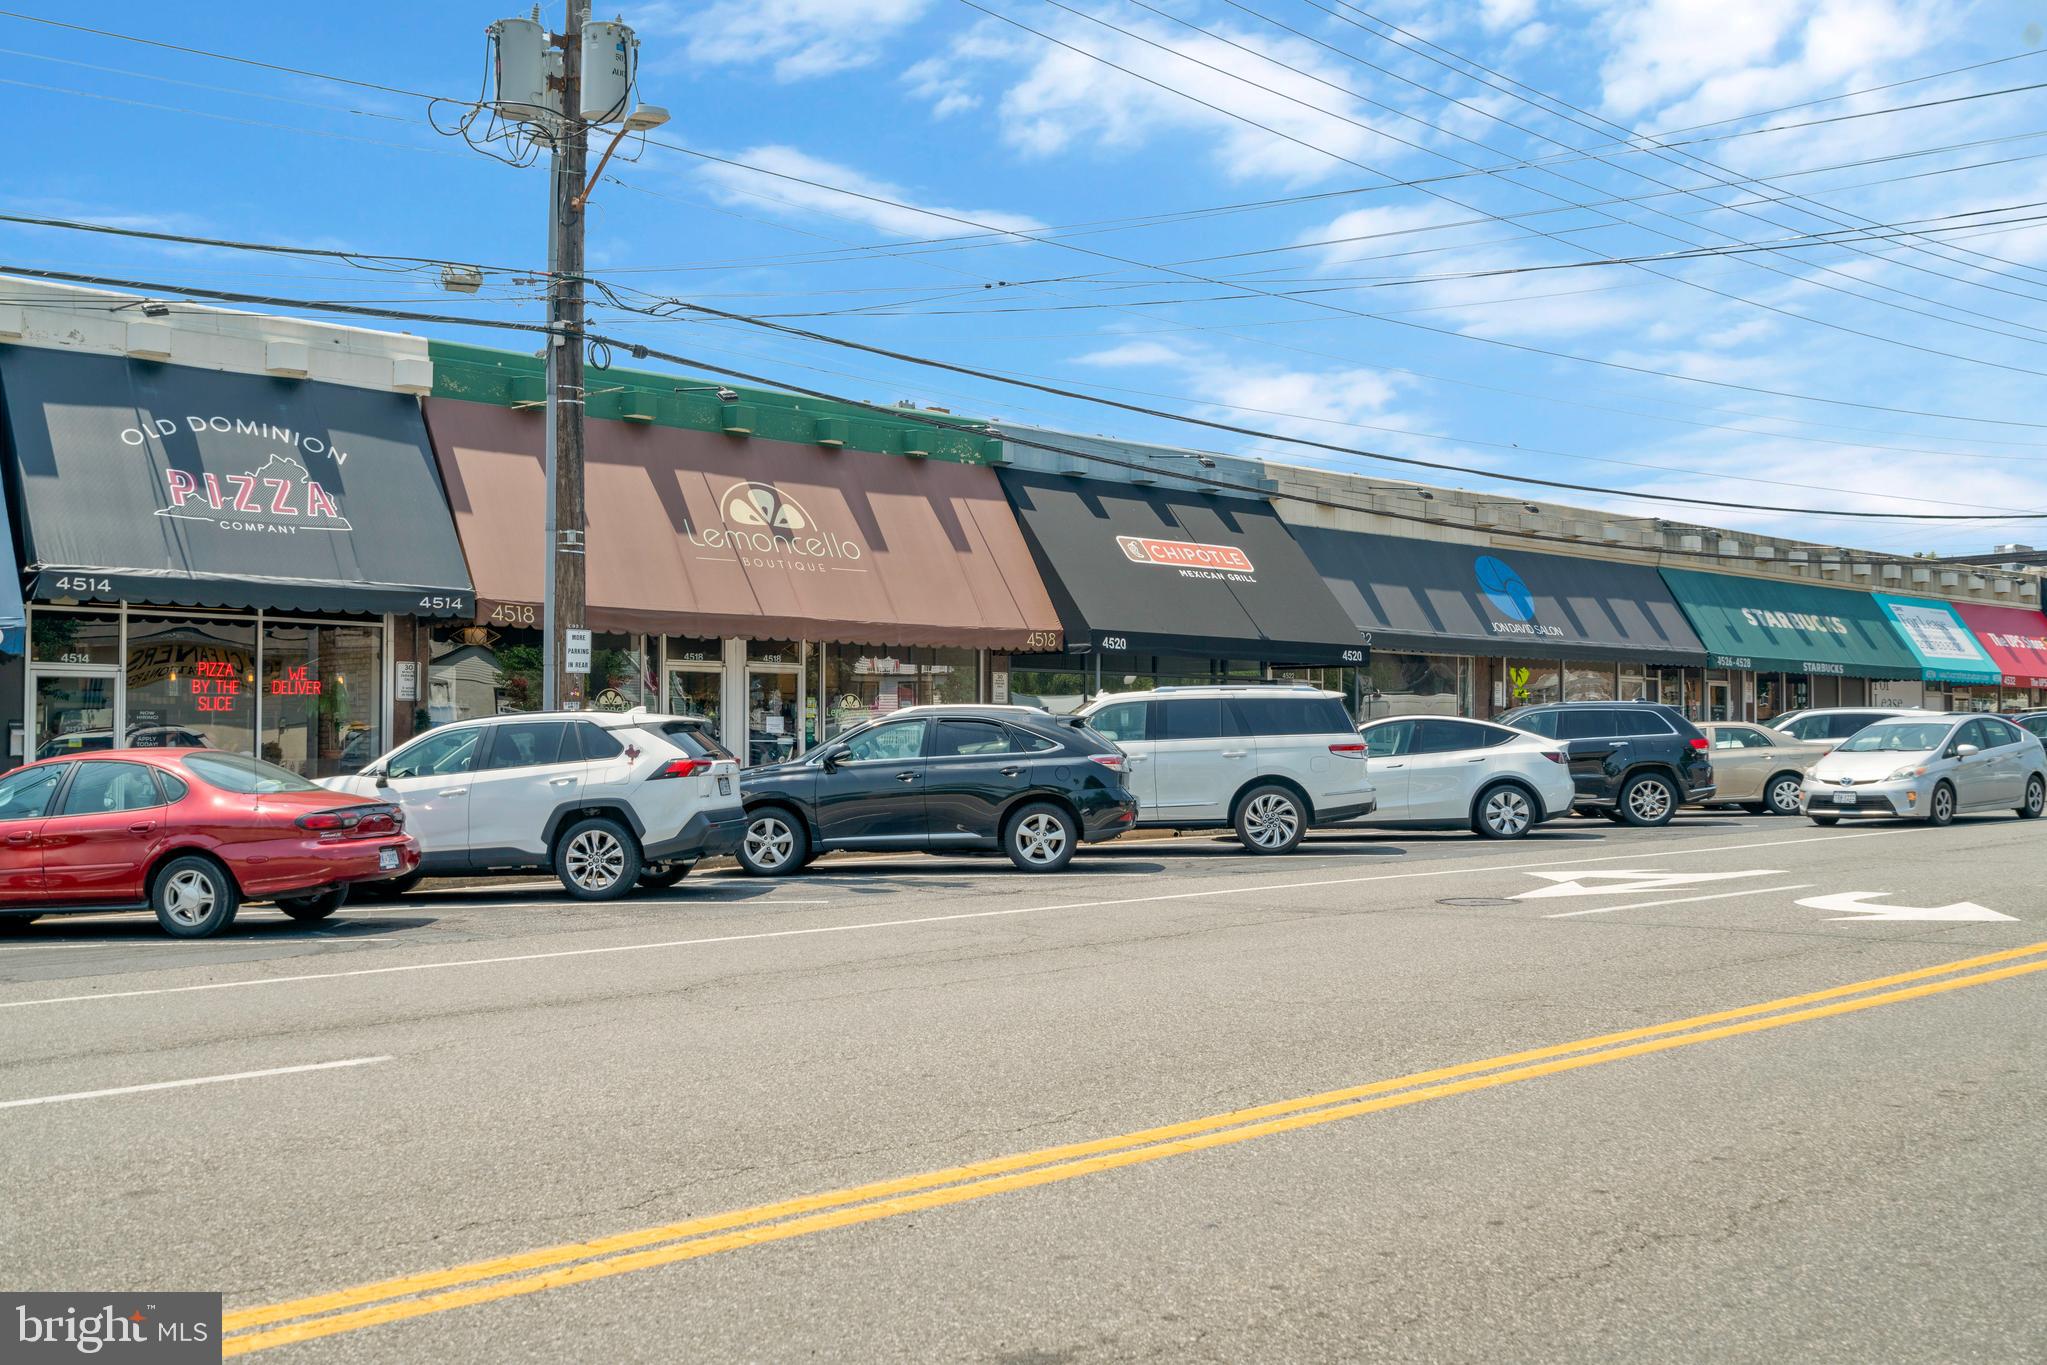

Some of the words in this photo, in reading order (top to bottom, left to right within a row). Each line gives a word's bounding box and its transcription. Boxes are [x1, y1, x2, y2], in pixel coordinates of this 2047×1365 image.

[121, 419, 177, 446] OLD
[186, 416, 348, 465] DOMINION
[166, 468, 338, 517] PIZZA
[219, 520, 296, 534] COMPANY
[683, 518, 861, 560] Lemoncello
[1150, 544, 1246, 567] CHIPOTLE
[742, 557, 827, 573] BOUTIQUE
[1178, 568, 1226, 581] MEXICAN
[1227, 572, 1257, 583] GRILL
[55, 576, 112, 592] 4514
[418, 596, 463, 609] 4514
[490, 604, 535, 623] 4518
[1740, 607, 1848, 634] STARBUCKS
[1507, 622, 1535, 634] DAVID
[1533, 624, 1564, 637] SALON
[1026, 632, 1056, 647] 4518
[1102, 636, 1127, 650] 4520
[60, 653, 90, 664] 4514
[683, 652, 704, 661] 4518
[762, 654, 782, 663] 4518
[1342, 649, 1363, 662] 4520
[1716, 656, 1751, 669] 4526-4528
[197, 661, 235, 677] PIZZA
[575, 661, 589, 669] REAR
[1802, 662, 1845, 674] STARBUCKS
[287, 666, 308, 681] WE
[191, 678, 210, 694] BY
[214, 679, 241, 695] THE
[271, 680, 322, 695] DELIVER
[197, 696, 233, 712] SLICE
